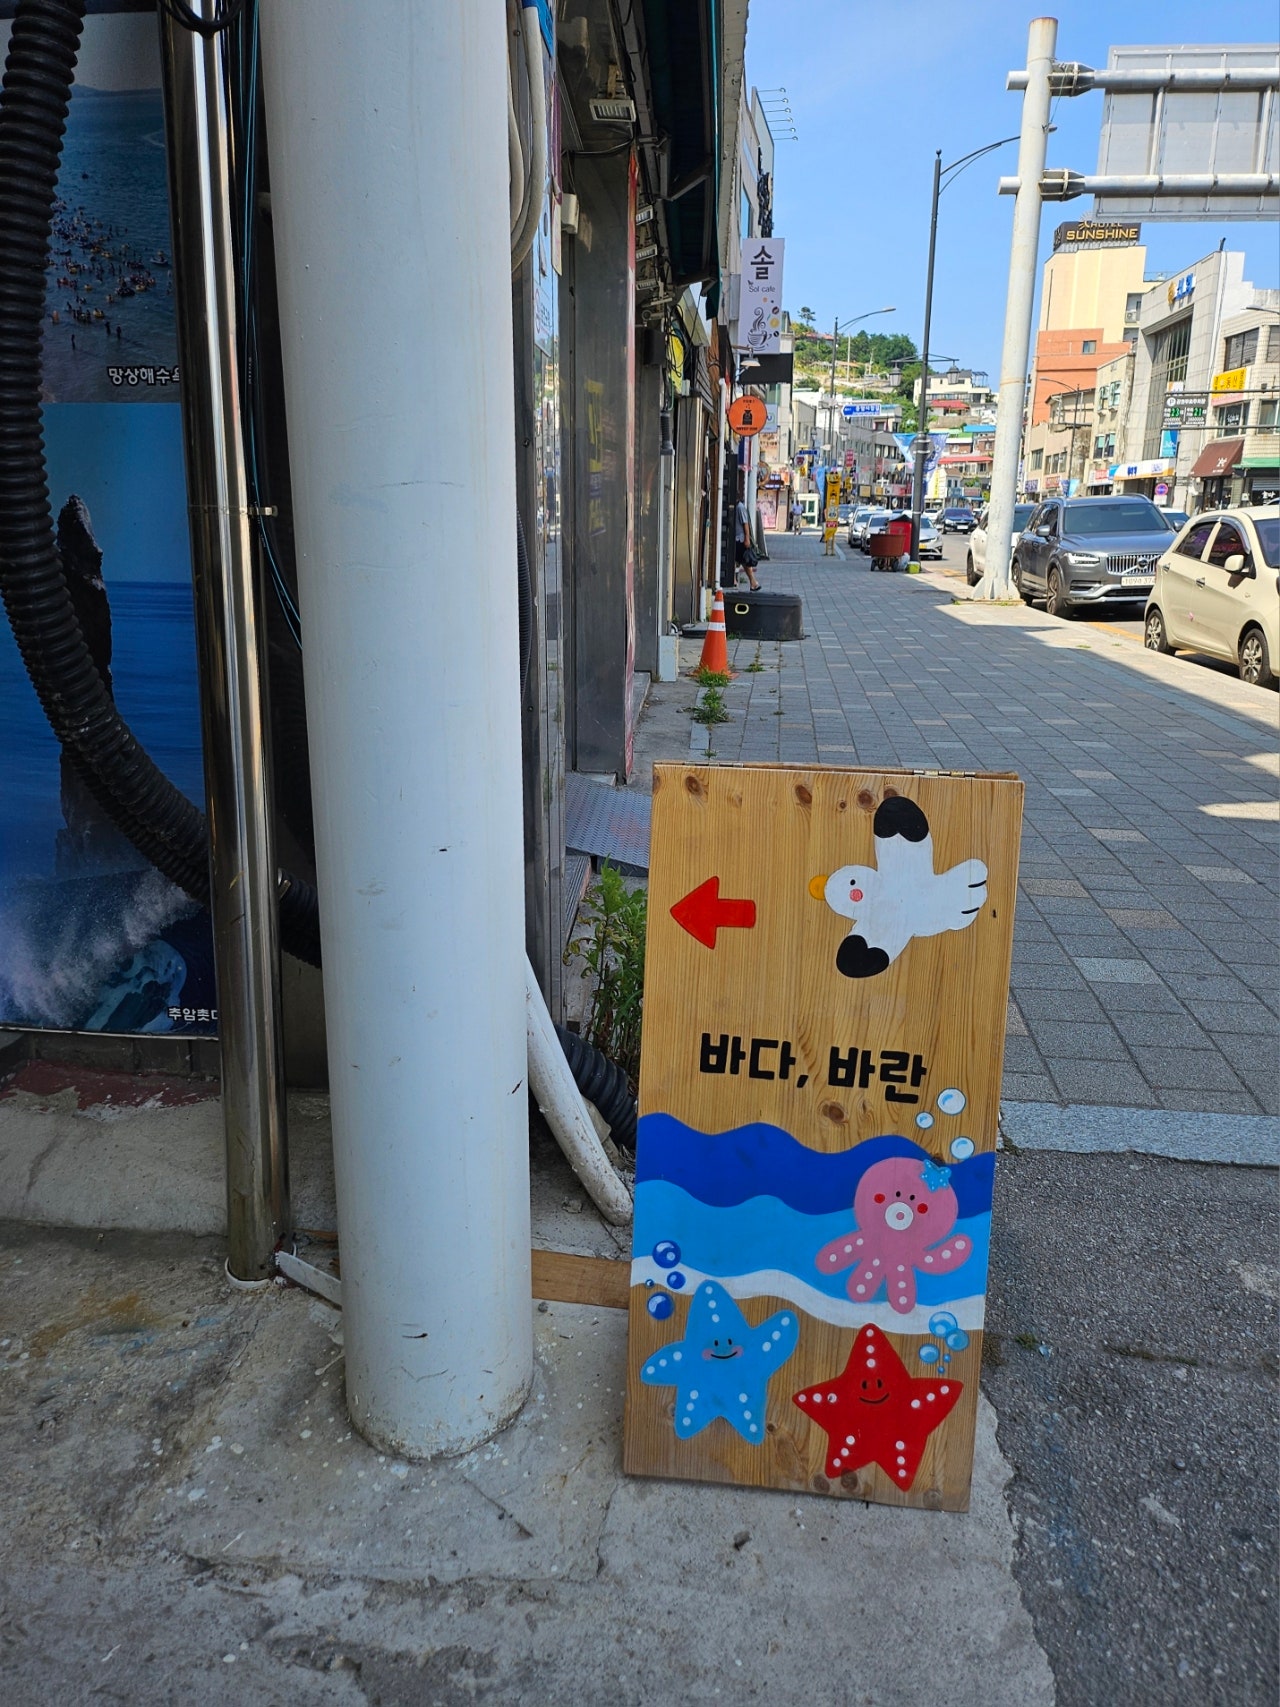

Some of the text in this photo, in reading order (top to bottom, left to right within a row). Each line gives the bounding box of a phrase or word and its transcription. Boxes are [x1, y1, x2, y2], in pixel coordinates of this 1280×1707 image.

[1066, 228, 1138, 241] SUNSHINE
[750, 245, 775, 280] 솔
[748, 285, 776, 293] Sol cafe
[700, 1032, 928, 1105] 바다, 바란
